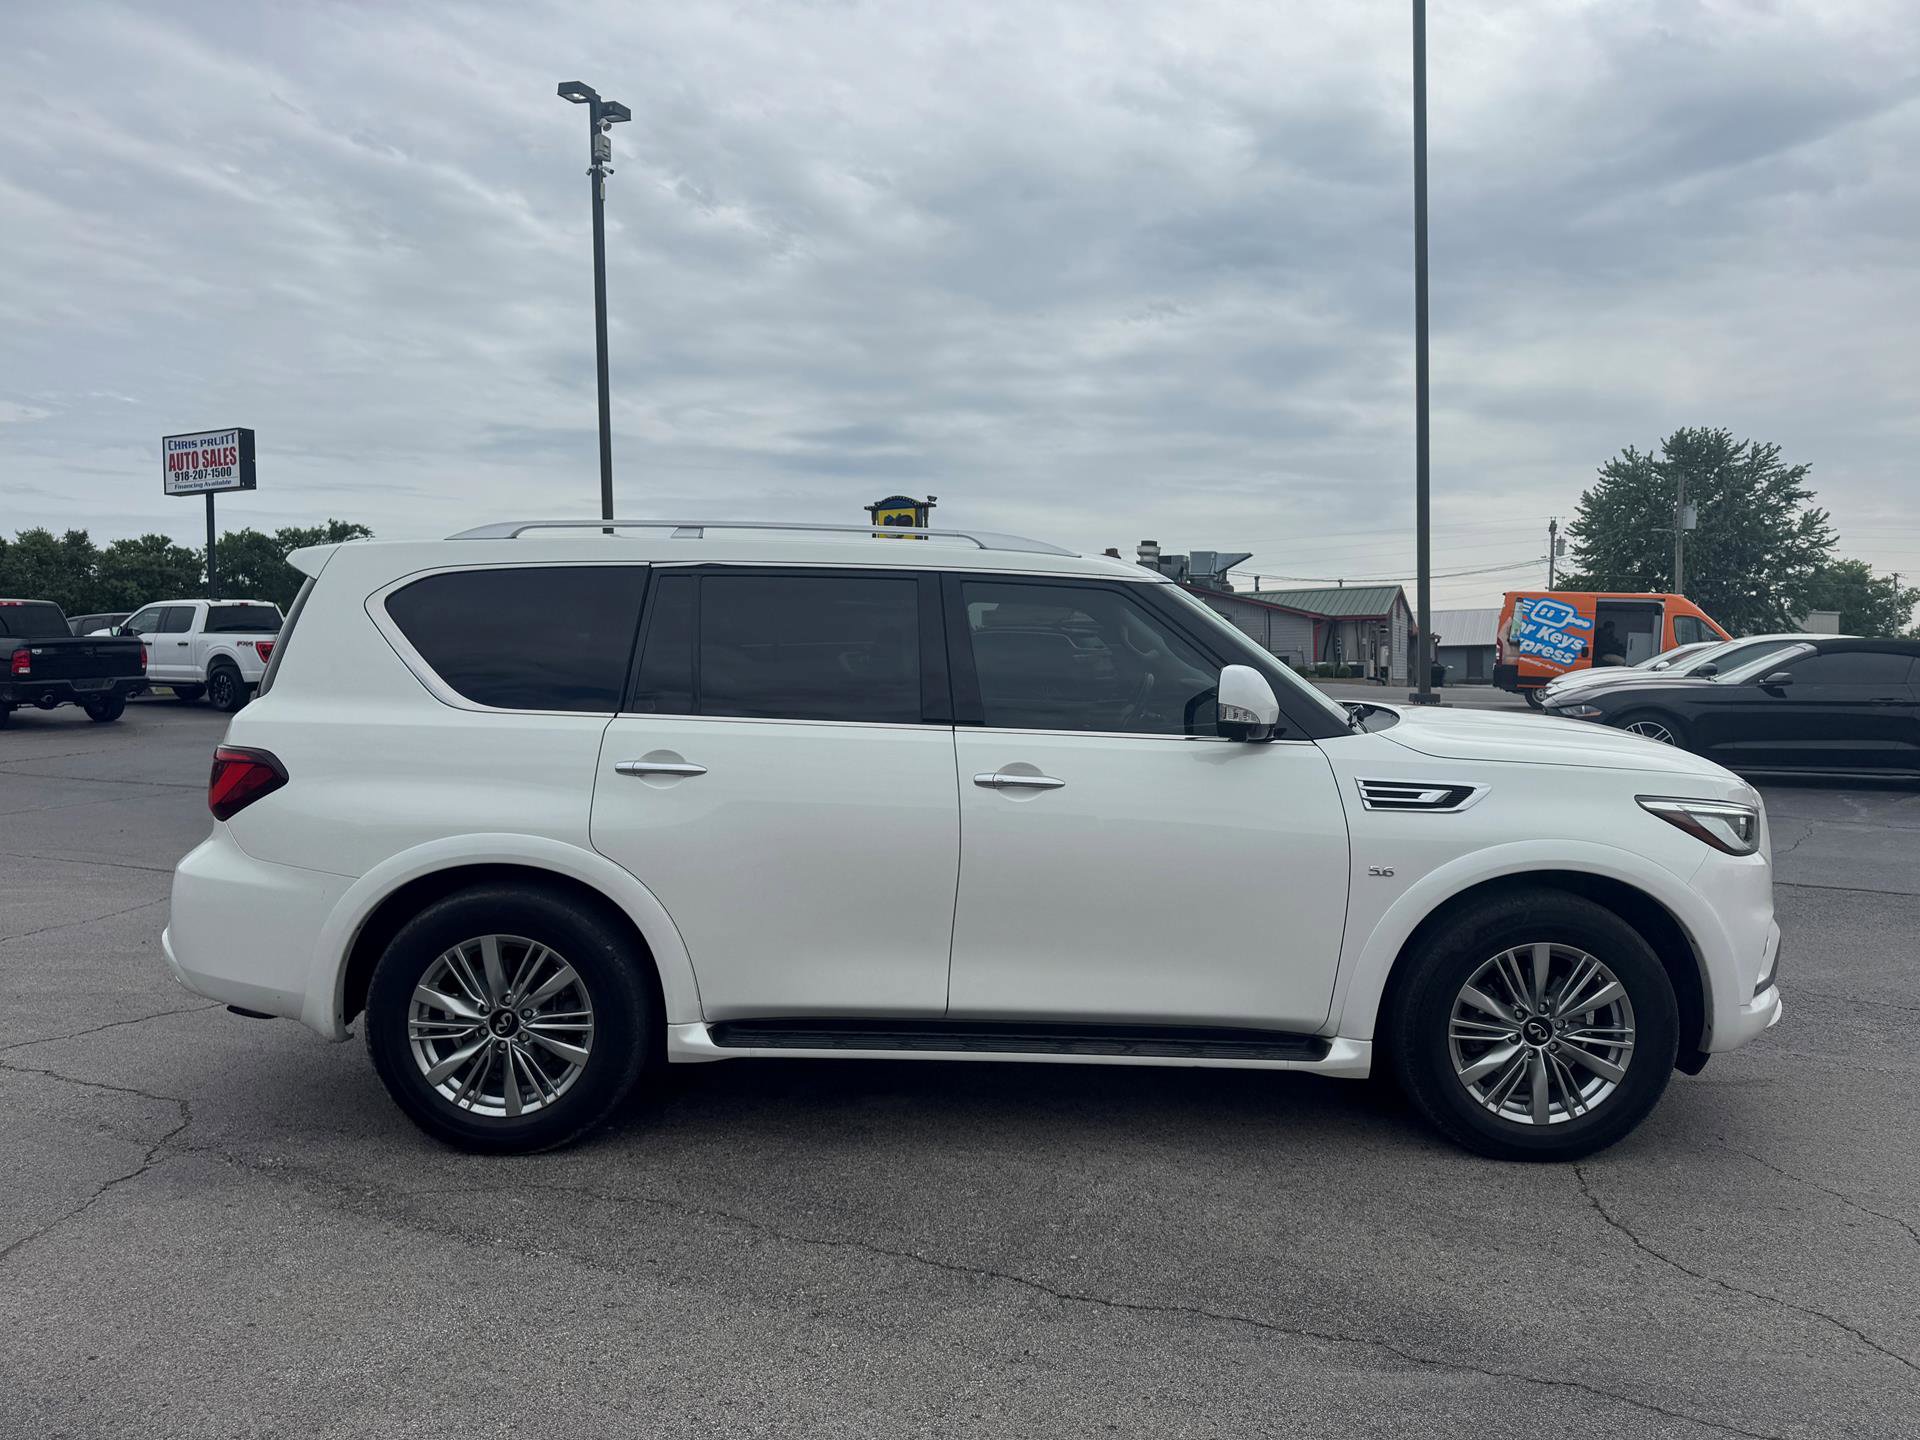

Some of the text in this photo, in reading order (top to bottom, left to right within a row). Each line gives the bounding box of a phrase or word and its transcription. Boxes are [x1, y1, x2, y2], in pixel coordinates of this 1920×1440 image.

[168, 432, 236, 451] CHRIS PRUITT
[168, 447, 237, 472] AUTO SALES
[174, 467, 232, 482] 918-207-1500
[174, 479, 232, 490] Financing Available
[1536, 625, 1585, 651] Keys
[1368, 865, 1395, 878] 5.6
